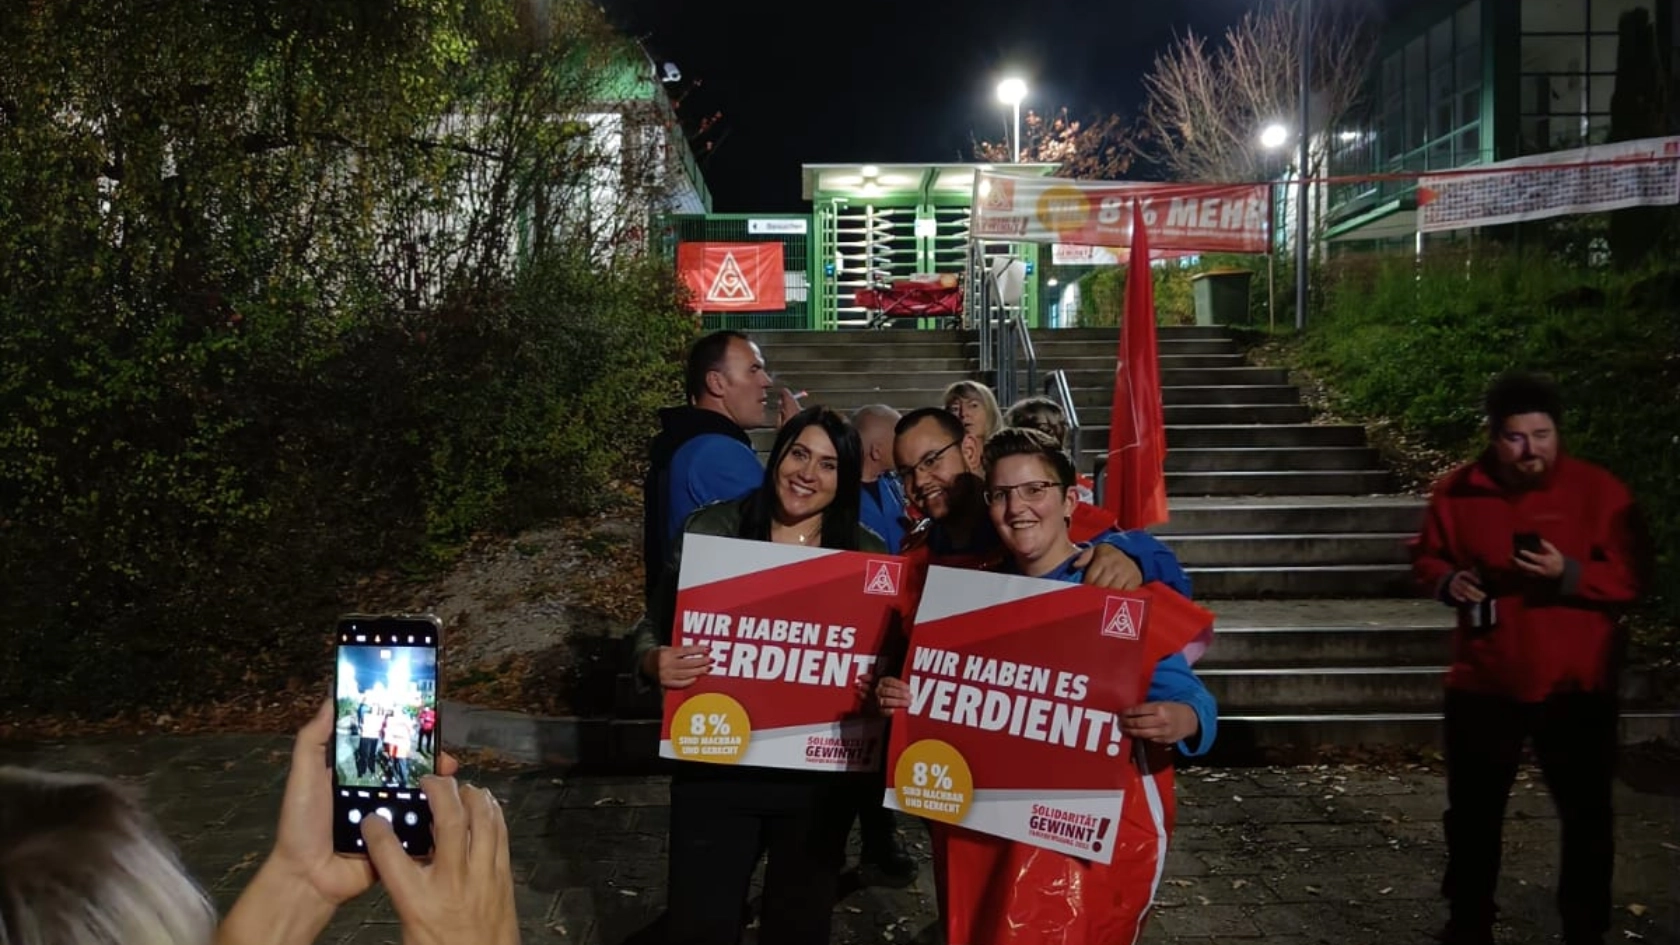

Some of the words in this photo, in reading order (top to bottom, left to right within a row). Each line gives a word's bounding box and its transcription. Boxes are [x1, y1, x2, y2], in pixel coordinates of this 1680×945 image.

[1166, 195, 1267, 230] MEHR
[682, 610, 731, 637] WIR
[736, 616, 821, 646] HABEN
[825, 625, 857, 650] ES
[912, 646, 960, 677] WIR
[963, 655, 1050, 695] HABEN
[1054, 672, 1090, 701] ES
[691, 713, 731, 735] 8%
[908, 675, 1122, 756] VERDIENT!
[912, 762, 953, 790] 8%
[1031, 804, 1098, 827] SOLIDARITÄT
